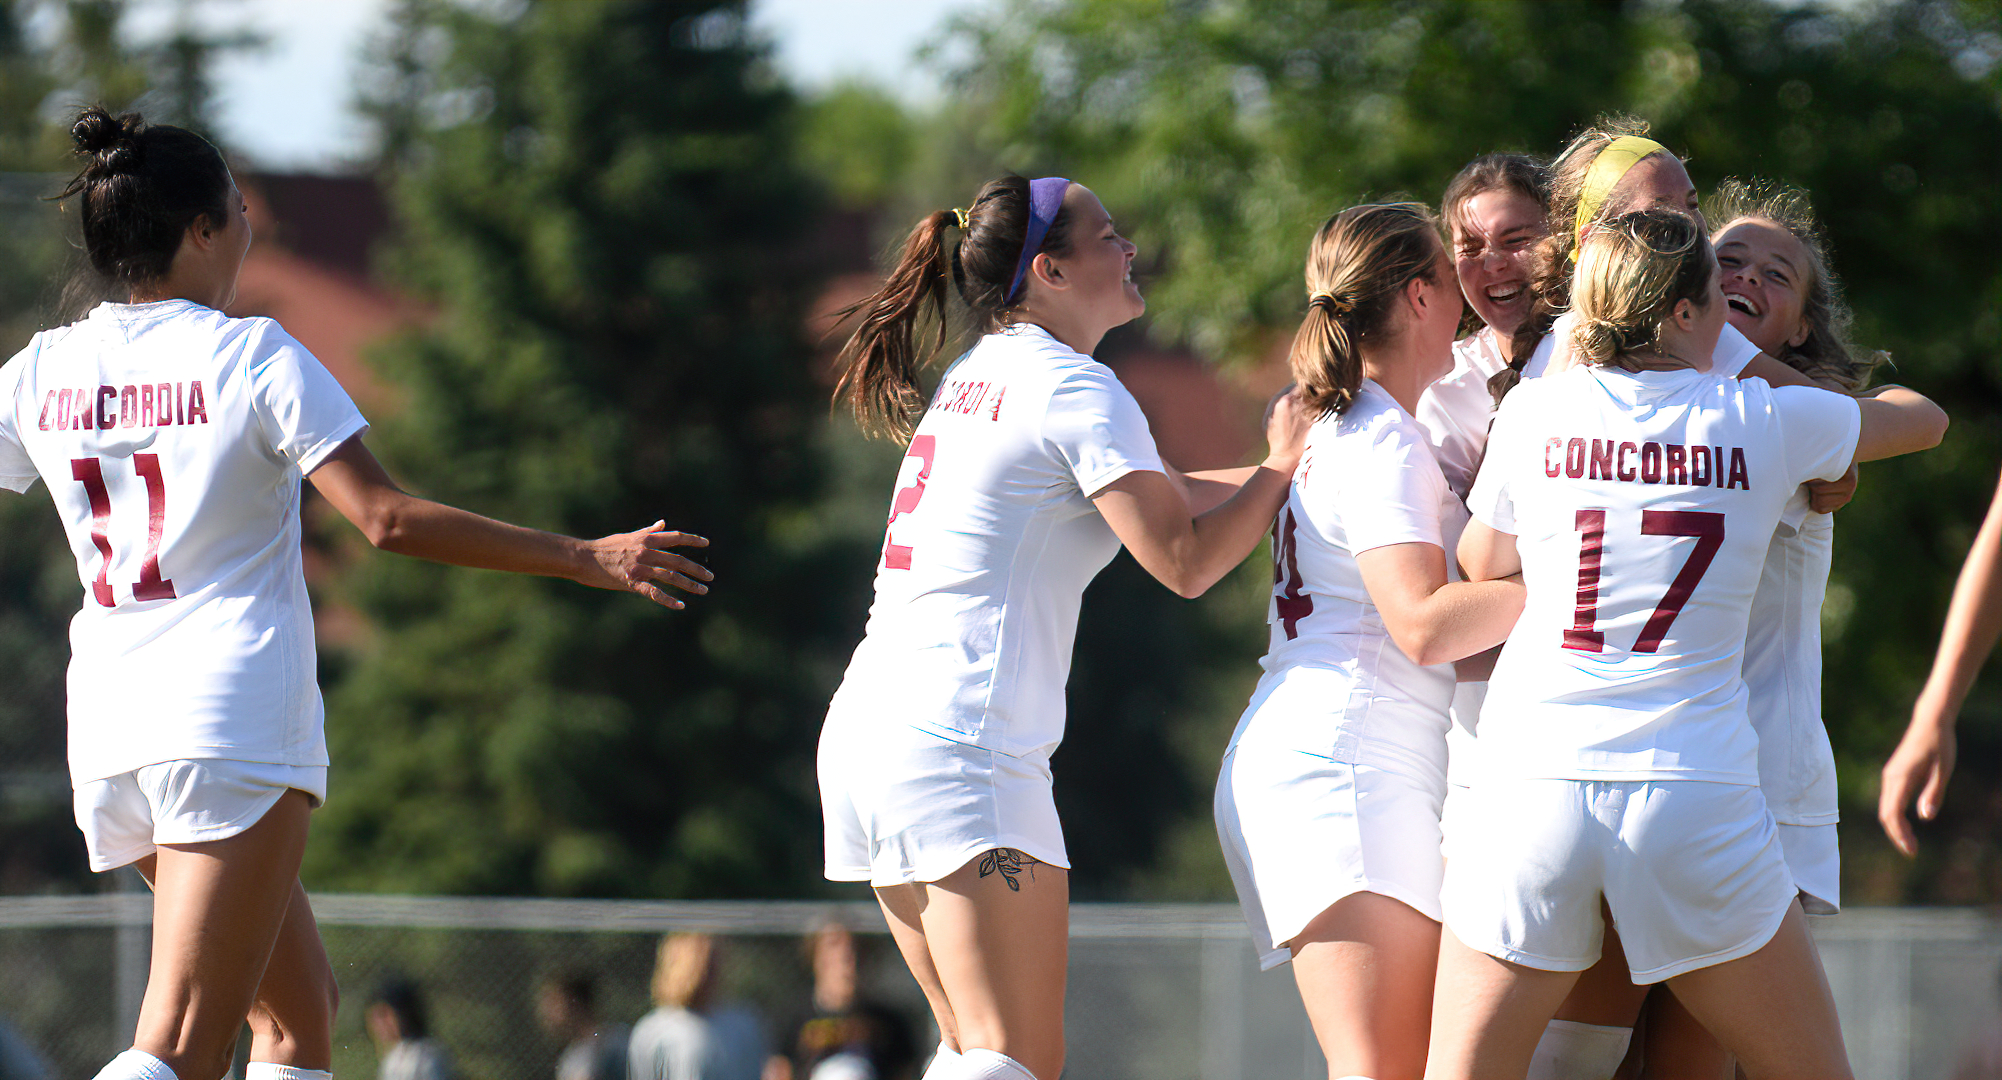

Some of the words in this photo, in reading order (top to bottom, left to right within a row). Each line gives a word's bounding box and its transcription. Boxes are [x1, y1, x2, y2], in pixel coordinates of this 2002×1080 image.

[39, 380, 208, 431] CONCORDIA
[1545, 436, 1750, 490] CONCORDIA
[71, 453, 177, 607] 11
[1561, 509, 1725, 653] 17
